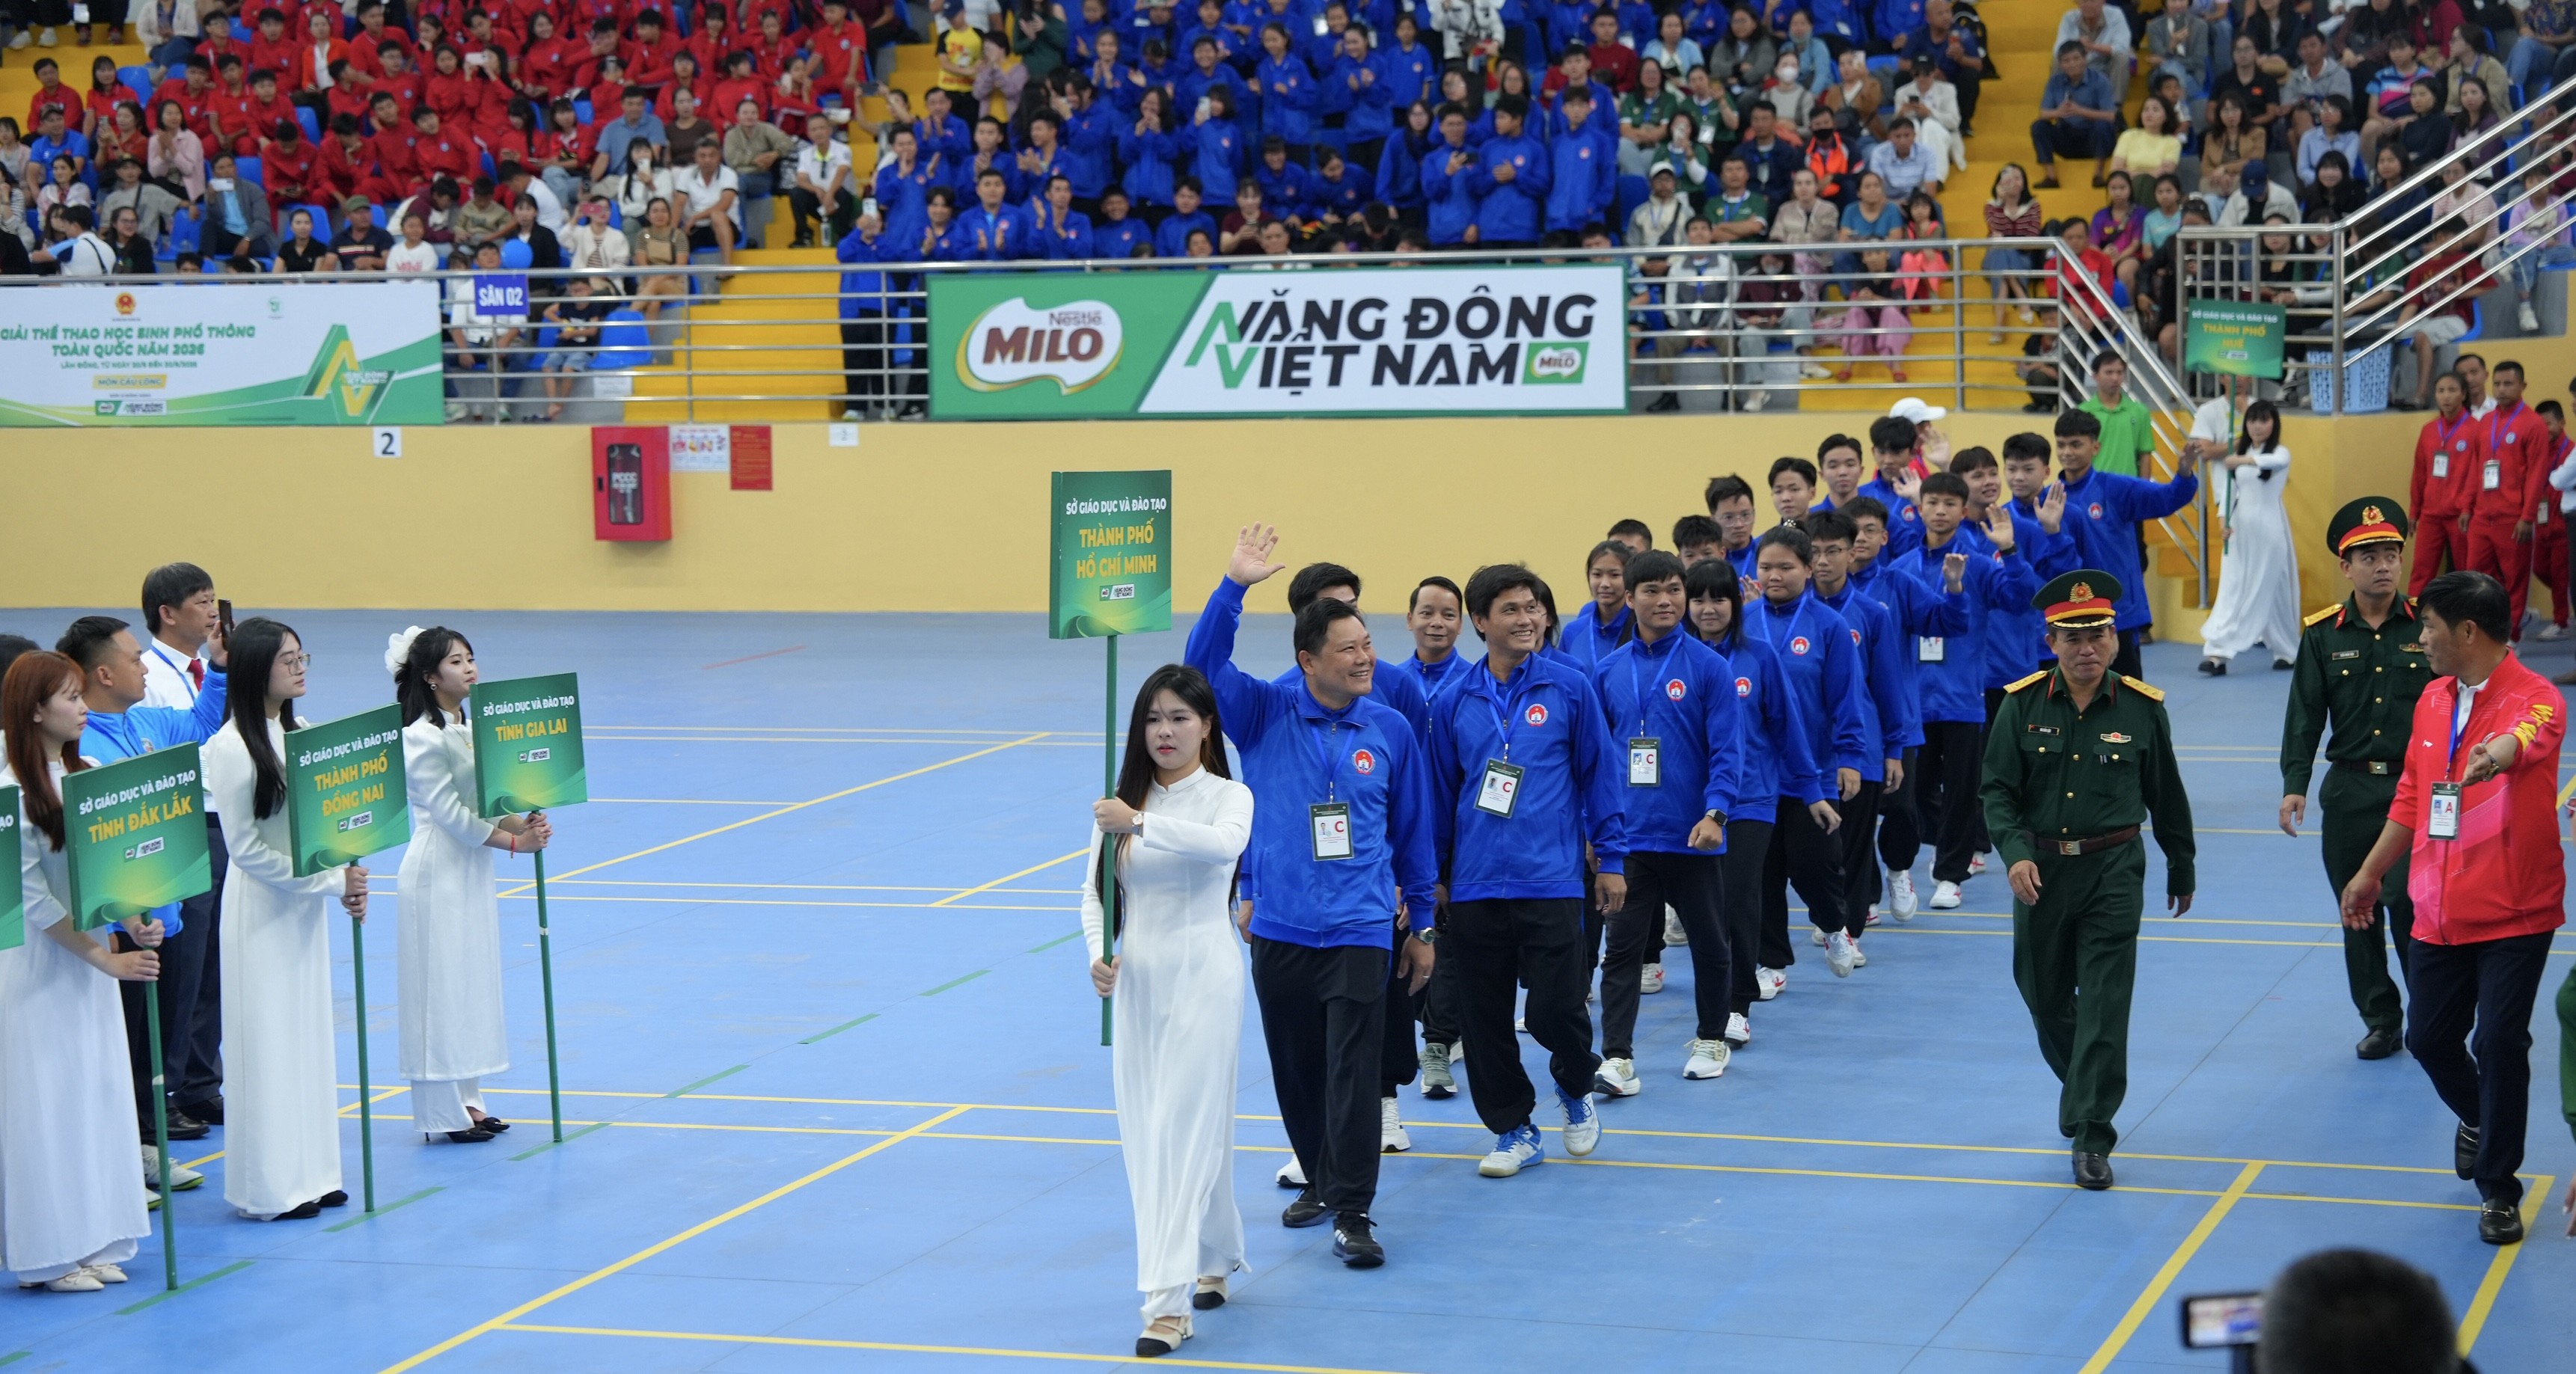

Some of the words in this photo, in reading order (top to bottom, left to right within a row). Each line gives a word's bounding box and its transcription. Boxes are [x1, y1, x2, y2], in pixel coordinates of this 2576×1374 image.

[479, 284, 504, 307] SÂN
[506, 286, 523, 307] 02
[1049, 310, 1101, 326] Nestlé
[1184, 288, 1388, 367] NĂNG
[1403, 284, 1597, 339] ĐỘNG
[2191, 308, 2202, 319] SỞ
[2203, 310, 2219, 320] GIÁO
[2220, 310, 2236, 321] DỤC
[2236, 310, 2246, 321] VÀ
[2247, 312, 2262, 322] ĐÀO
[2263, 314, 2278, 323] TẠO
[62, 328, 100, 340] THAO
[104, 327, 133, 342] HỌC
[138, 327, 170, 339] SINH
[207, 322, 256, 338] THÔNG
[2203, 322, 2240, 335] THÀNH
[2242, 323, 2266, 337] PHỐ
[52, 341, 90, 356] TOÀN
[94, 340, 134, 358] QUỐC
[138, 341, 169, 355] NĂM
[173, 343, 205, 355] 2026
[983, 326, 1104, 364] MILO
[1215, 334, 1359, 395] VIỆT
[1371, 343, 1520, 385] NAM
[1538, 355, 1574, 368] MILO
[380, 432, 395, 456] 2
[1066, 498, 1077, 515] SỞ
[1079, 498, 1099, 514] GIÁO
[1101, 500, 1118, 516] DỤC
[1120, 497, 1131, 512] VÀ
[1132, 496, 1150, 512] ĐÀO
[1151, 497, 1167, 513] TẠO
[1079, 522, 1125, 548] THÀNH
[1128, 518, 1154, 545] PHỐ
[1077, 551, 1097, 579] HỒ
[1100, 551, 1122, 578] CHÍ
[1125, 554, 1157, 575] MINH
[483, 702, 495, 716] SỞ
[495, 701, 514, 715] GIÁO
[515, 701, 530, 714] DỤC
[531, 696, 542, 710] VÀ
[542, 695, 559, 709] ĐÀO
[560, 696, 575, 708] TẠO
[495, 720, 524, 742] TỈNH
[526, 720, 547, 738] GIA
[548, 717, 567, 734] LAI
[300, 752, 311, 767] SỞ
[313, 747, 332, 763] GIÁO
[334, 743, 351, 758] DỤC
[351, 737, 363, 752] VÀ
[364, 733, 382, 749] ĐÀO
[382, 729, 398, 745] TẠO
[1646, 754, 1653, 764] C
[314, 766, 359, 792] THÀNH
[361, 749, 388, 779] PHỐ
[79, 797, 93, 815] SỞ
[95, 793, 117, 812] GIÁO
[120, 787, 140, 804] DỤC
[141, 779, 155, 796] VÀ
[156, 775, 176, 792] ĐÀO
[177, 770, 196, 786] TẠO
[1502, 782, 1512, 793] C
[322, 789, 359, 817] ĐỒNG
[362, 783, 385, 805] NAI
[2444, 802, 2453, 813] A
[0, 815, 14, 832] ẠO
[88, 816, 125, 844] TỈNH
[127, 801, 161, 832] ĐẮK
[163, 791, 193, 821] LẮK
[1335, 821, 1344, 832] C
